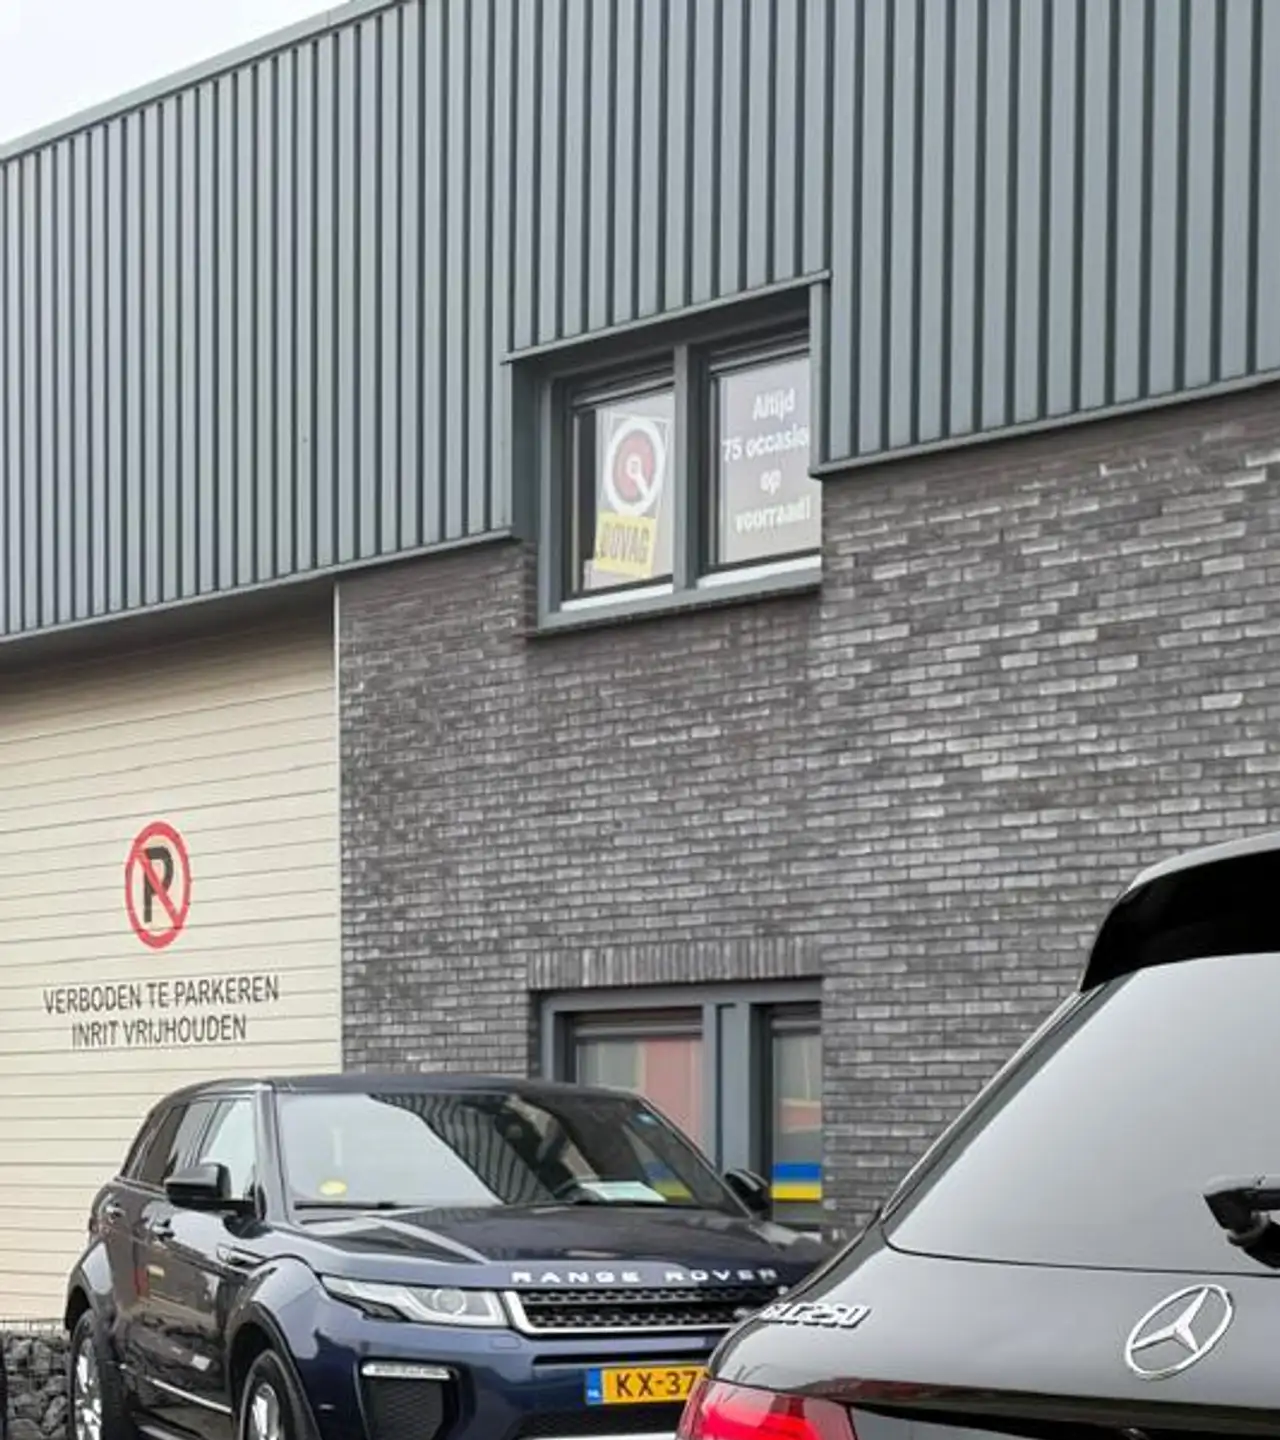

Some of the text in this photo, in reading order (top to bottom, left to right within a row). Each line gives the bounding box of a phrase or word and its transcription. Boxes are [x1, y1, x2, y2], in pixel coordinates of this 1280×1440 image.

[721, 435, 743, 462] 75
[760, 468, 782, 496] op
[43, 974, 280, 1015] VERBODEN TE PARKEREN
[71, 1013, 248, 1049] INRIT VRIJHOUDEN
[511, 1269, 779, 1284] RANGE ROVER
[615, 1369, 698, 1399] KX-37
